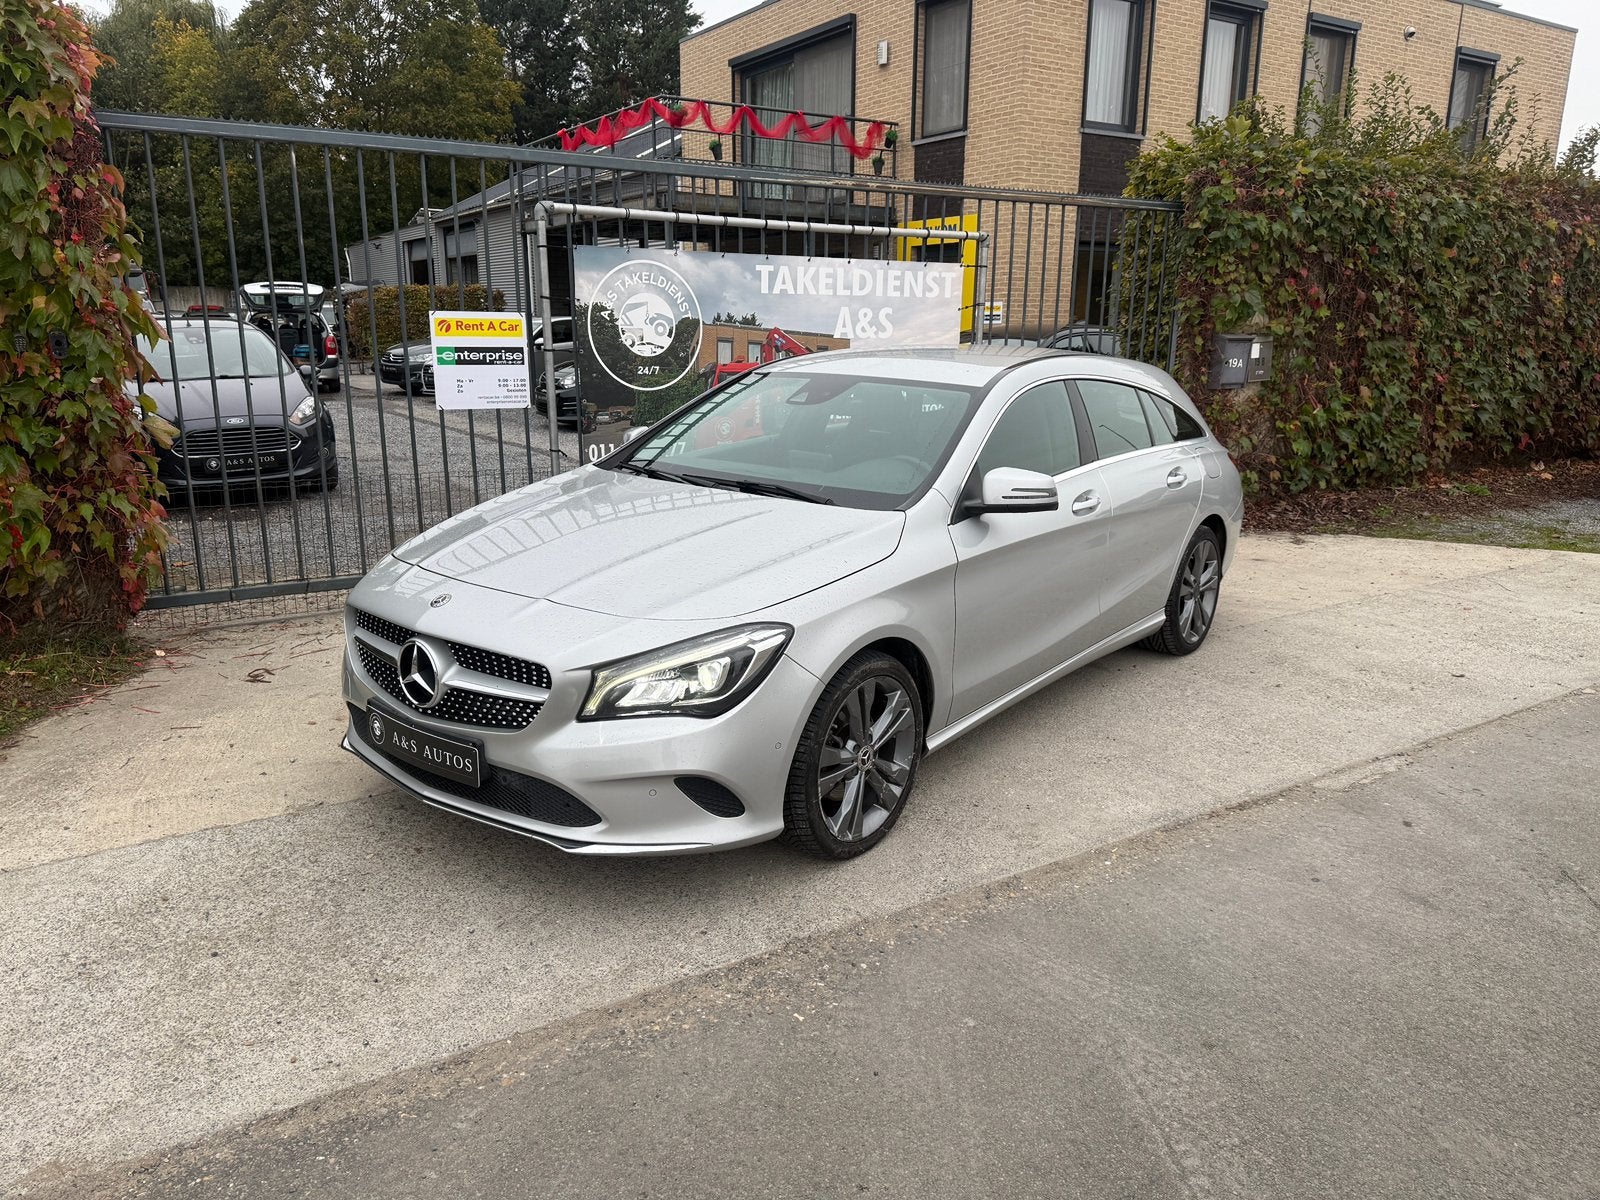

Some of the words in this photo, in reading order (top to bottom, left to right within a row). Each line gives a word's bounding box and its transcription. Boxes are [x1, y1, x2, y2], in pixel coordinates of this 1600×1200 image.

[755, 264, 956, 298] TAKELDIENST
[600, 290, 618, 321] A&S
[614, 271, 692, 320] TAKELDIENST
[455, 320, 485, 331] Rent
[487, 321, 497, 331] A
[499, 321, 520, 332] Car
[833, 306, 893, 339] A&S
[440, 350, 523, 363] enterprise
[1228, 358, 1243, 368] 19A
[637, 366, 660, 375] 24/7
[247, 455, 275, 465] ATOS
[392, 731, 417, 753] A&S
[423, 745, 473, 772] AUTOS
